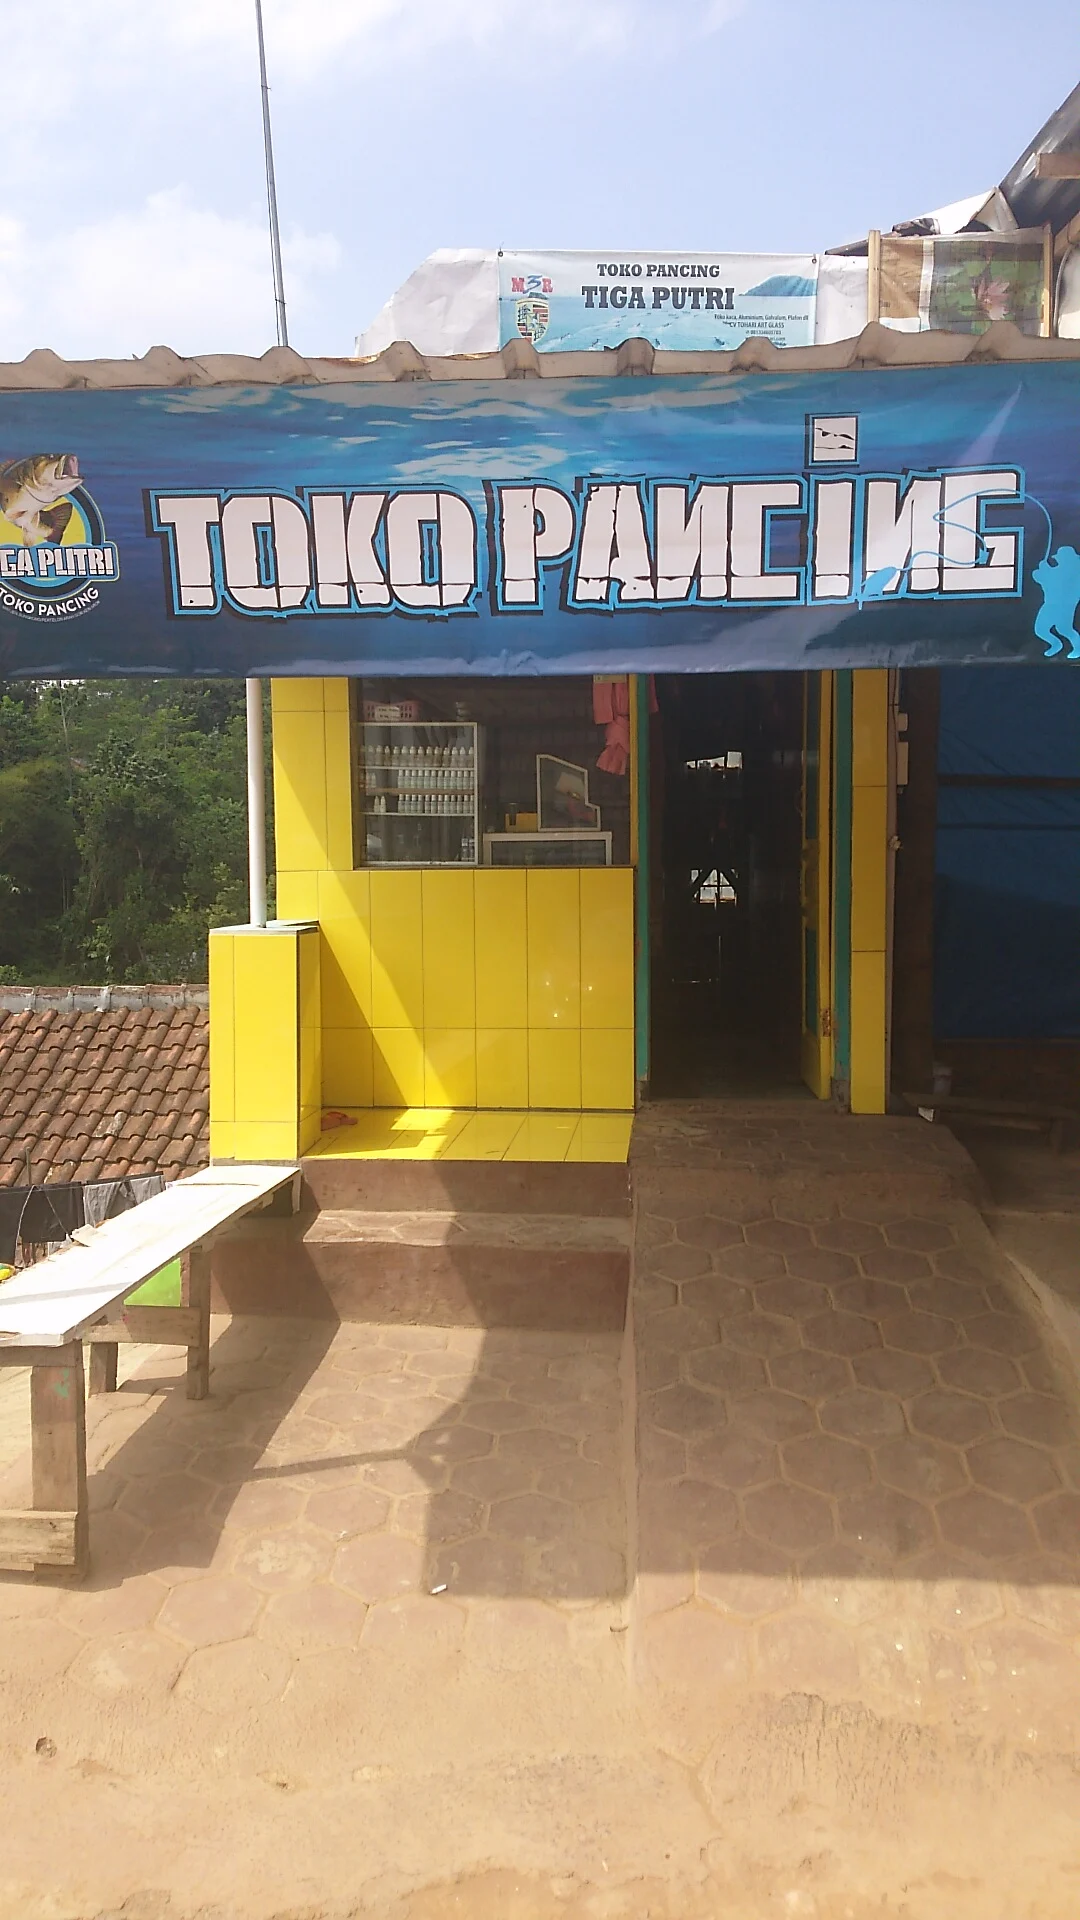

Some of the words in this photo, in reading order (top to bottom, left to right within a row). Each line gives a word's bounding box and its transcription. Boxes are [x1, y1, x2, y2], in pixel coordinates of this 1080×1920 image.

[597, 263, 642, 277] TOKO
[646, 264, 720, 278] PANCING
[581, 285, 646, 309] TIGA
[652, 286, 735, 310] PUTRI
[37, 547, 115, 577] PUTRI
[153, 489, 480, 614] TOKO
[38, 587, 99, 616] PANCING
